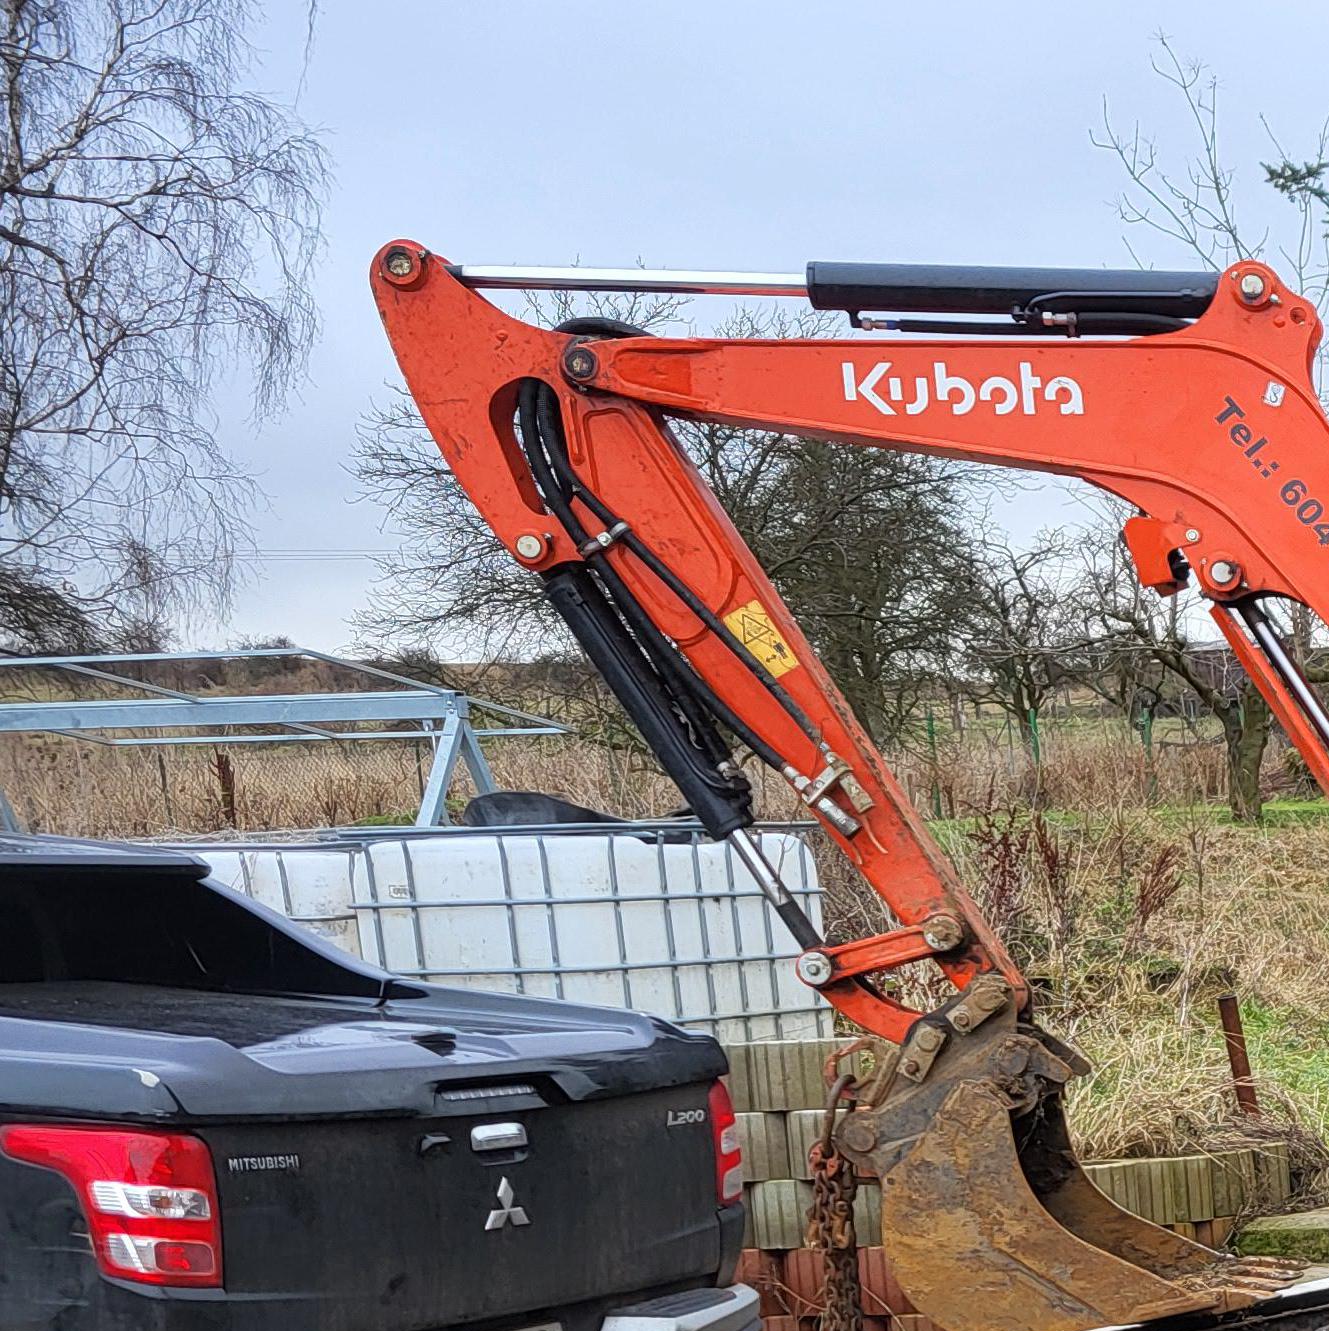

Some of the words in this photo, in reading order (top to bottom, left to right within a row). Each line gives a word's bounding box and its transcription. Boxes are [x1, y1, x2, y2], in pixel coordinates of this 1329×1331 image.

[841, 362, 1084, 415] Kubota
[1215, 396, 1280, 478] Tel.:
[667, 1109, 704, 1127] L200
[228, 1154, 300, 1171] MITSUBISHI
